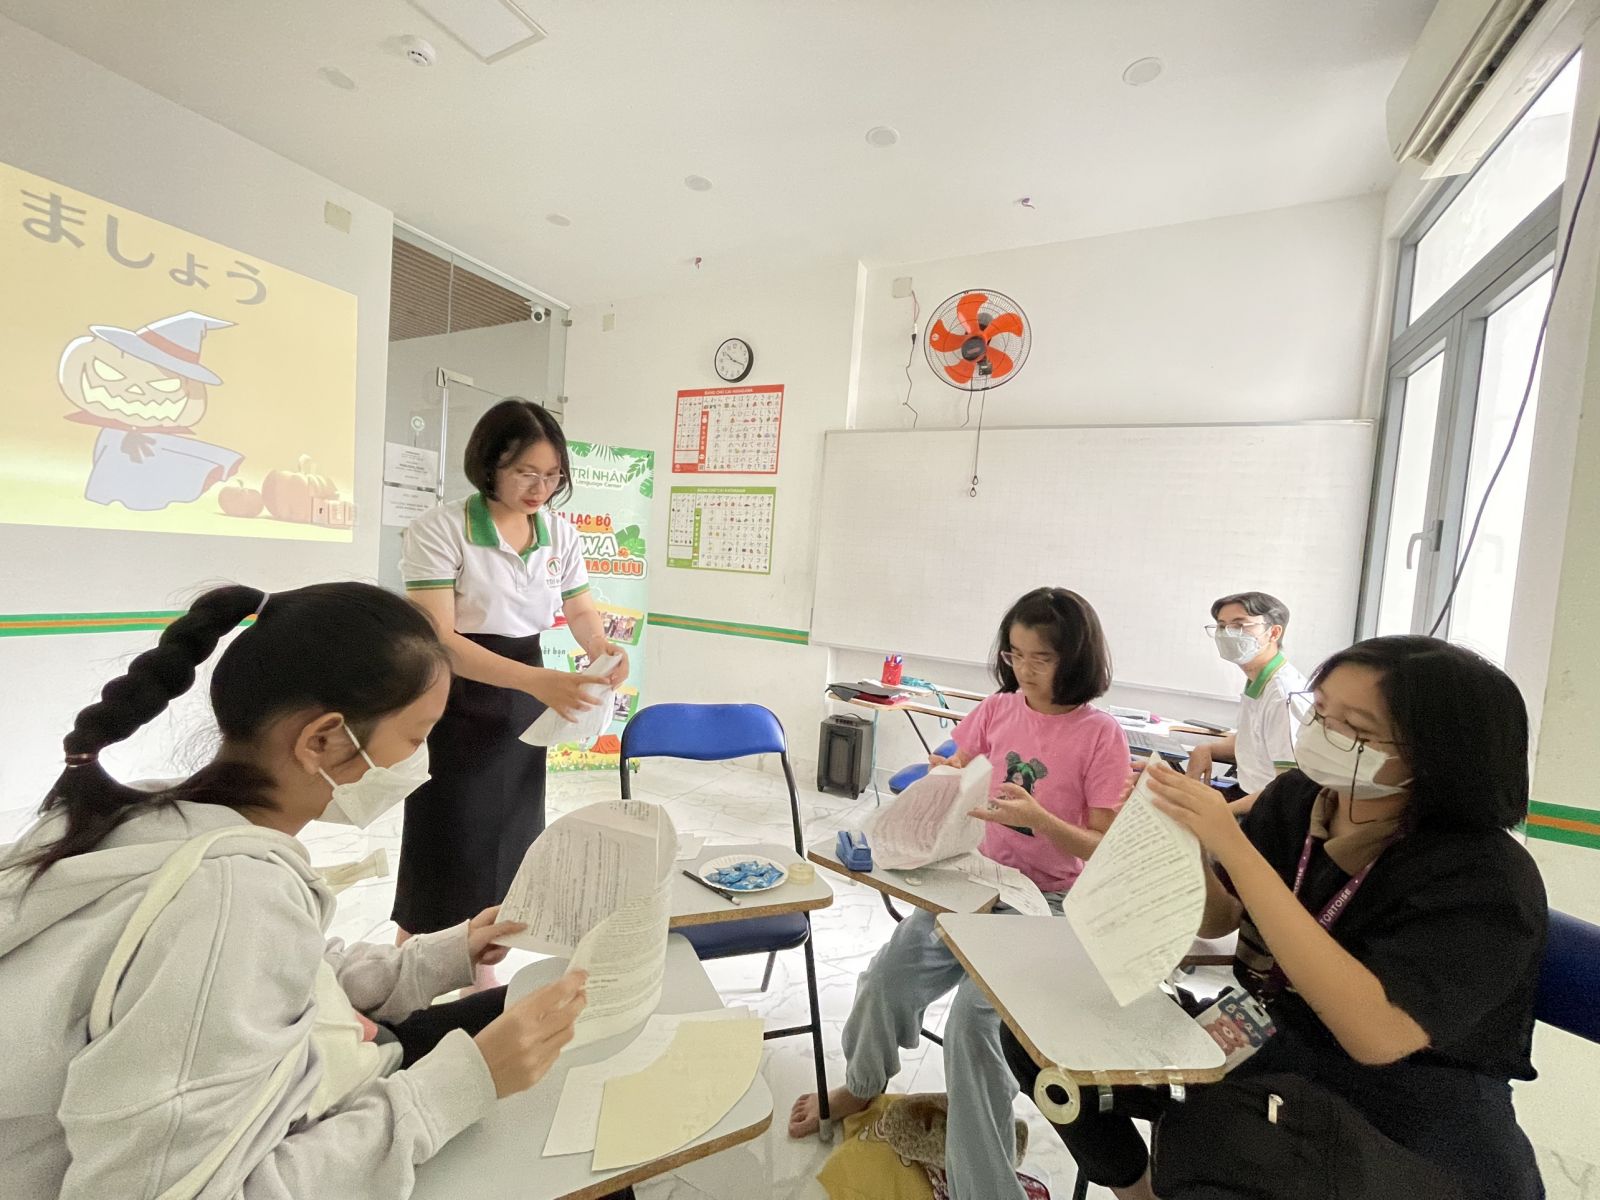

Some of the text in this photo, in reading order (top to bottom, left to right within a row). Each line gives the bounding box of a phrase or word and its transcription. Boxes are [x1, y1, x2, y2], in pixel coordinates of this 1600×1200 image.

[20, 189, 268, 305] ましょう
[570, 512, 592, 529] LẠC
[595, 513, 612, 531] BỘ
[579, 535, 617, 557] WA
[584, 558, 611, 573] IAO
